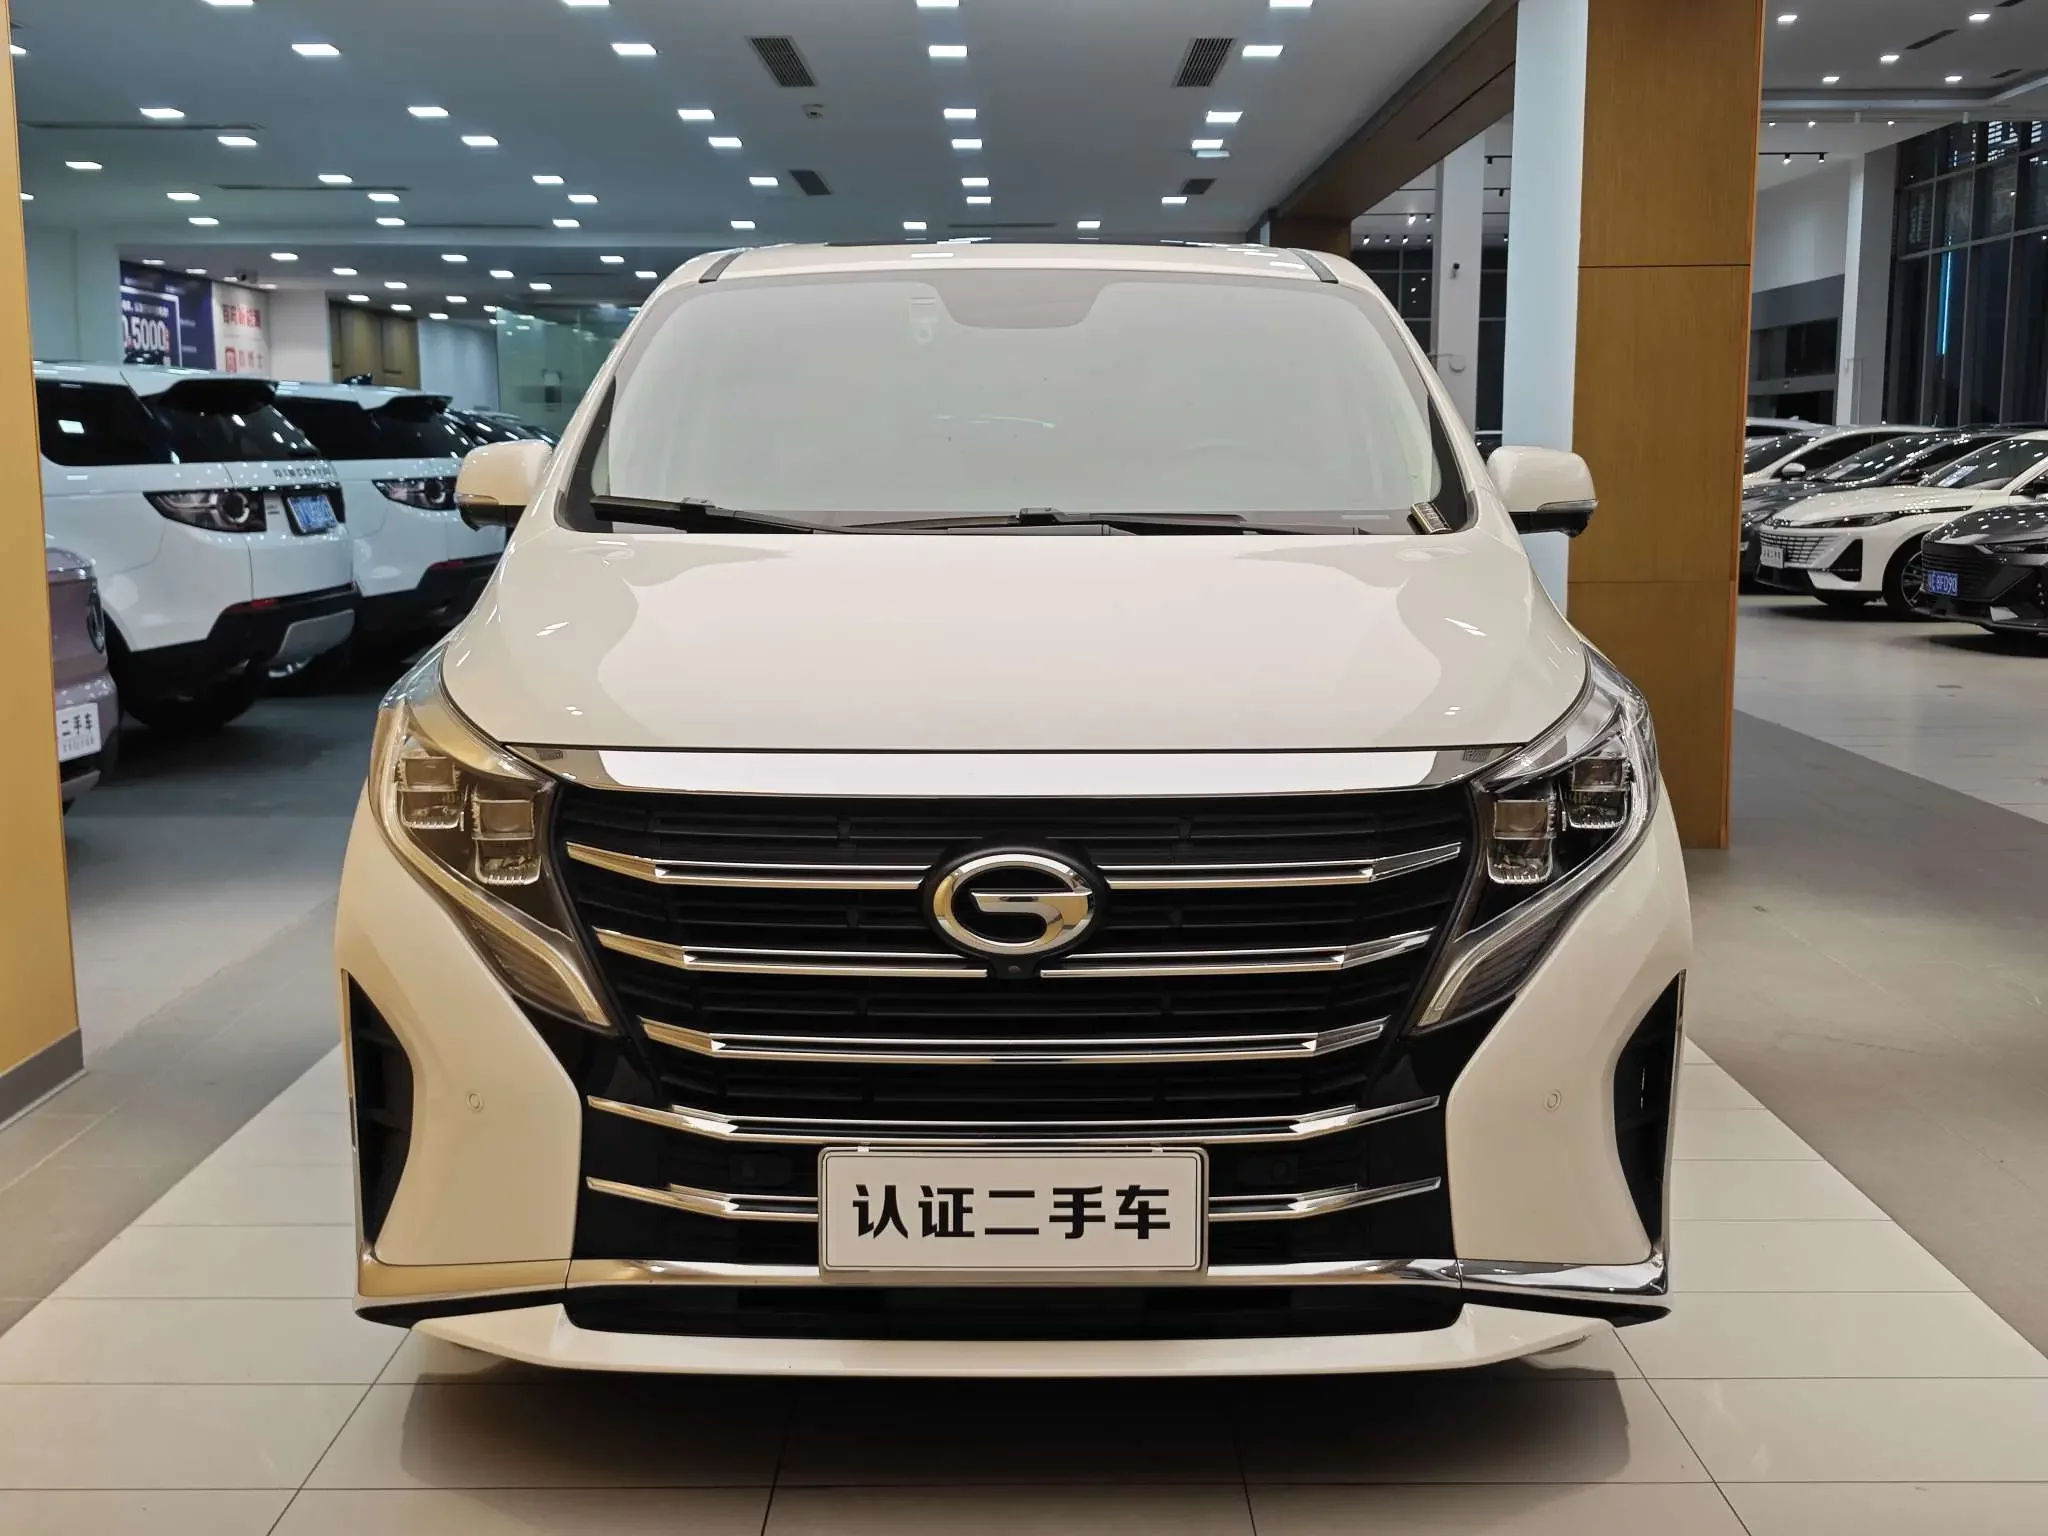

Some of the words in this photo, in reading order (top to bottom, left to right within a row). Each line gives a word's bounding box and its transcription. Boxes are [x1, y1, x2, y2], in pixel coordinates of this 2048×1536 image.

[853, 1185, 1170, 1240] 认证二手车
